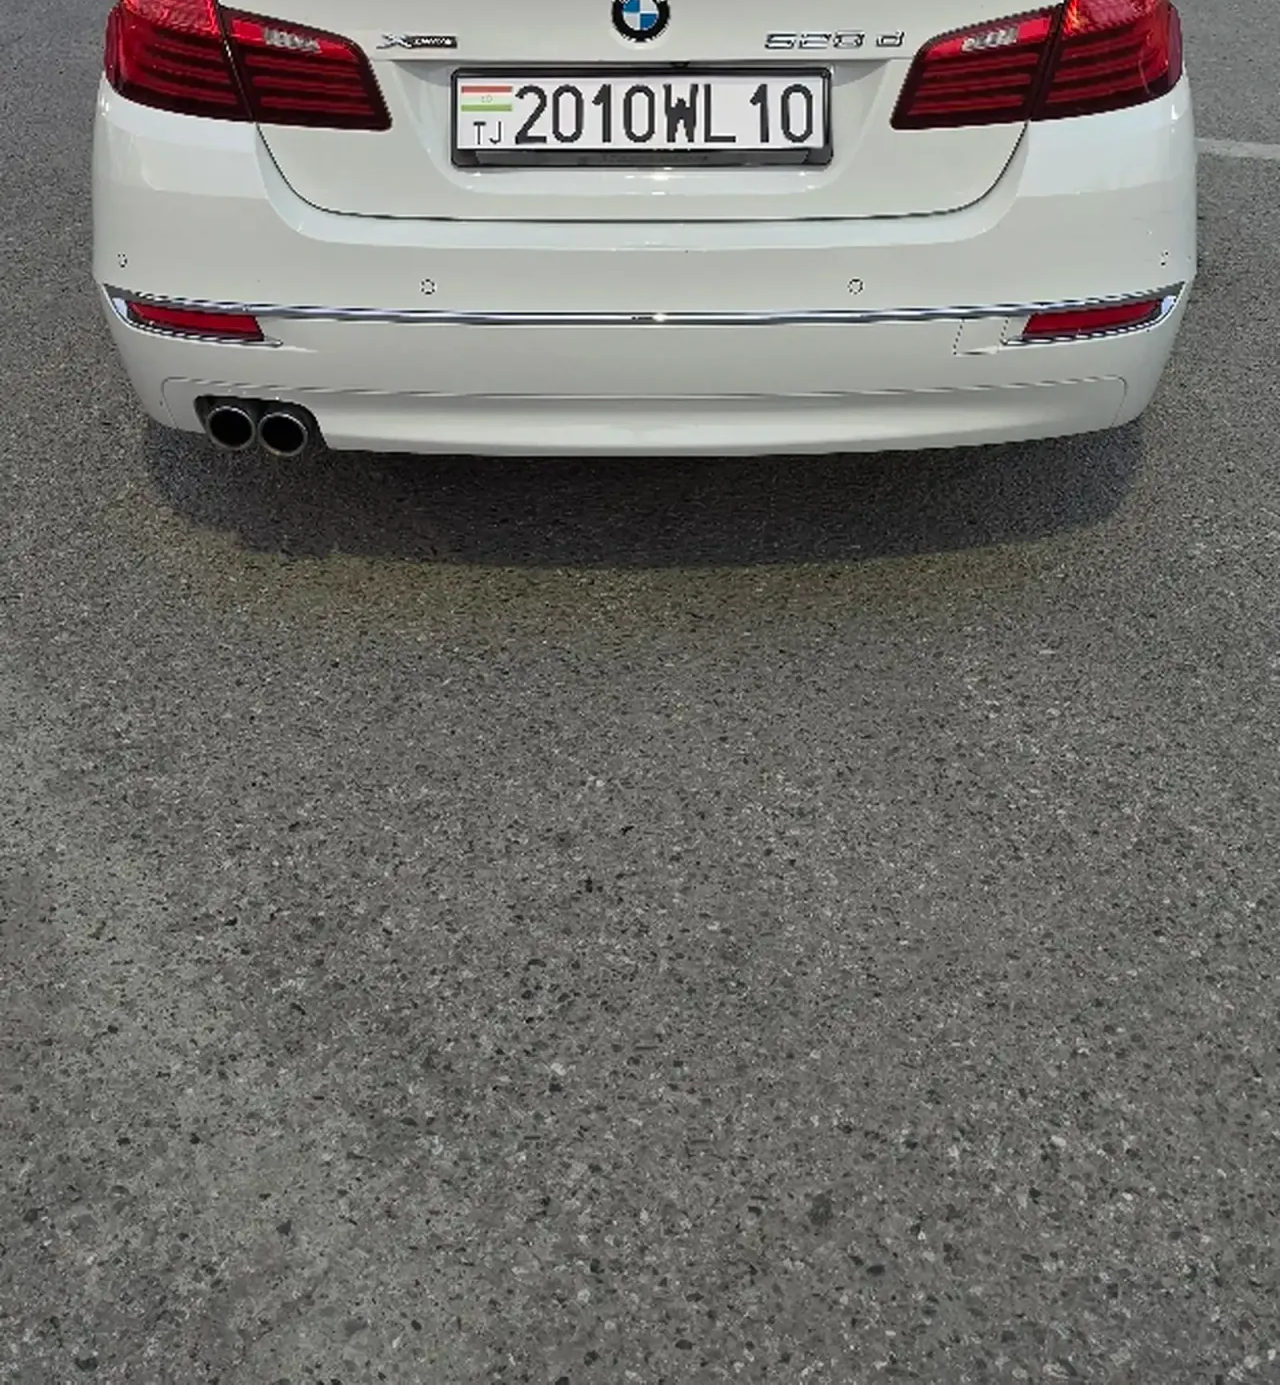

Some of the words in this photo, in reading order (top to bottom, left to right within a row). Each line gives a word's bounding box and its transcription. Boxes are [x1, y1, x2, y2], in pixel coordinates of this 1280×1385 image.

[472, 120, 503, 145] TJ
[514, 83, 737, 145] 2010WL
[749, 83, 814, 144] 10
